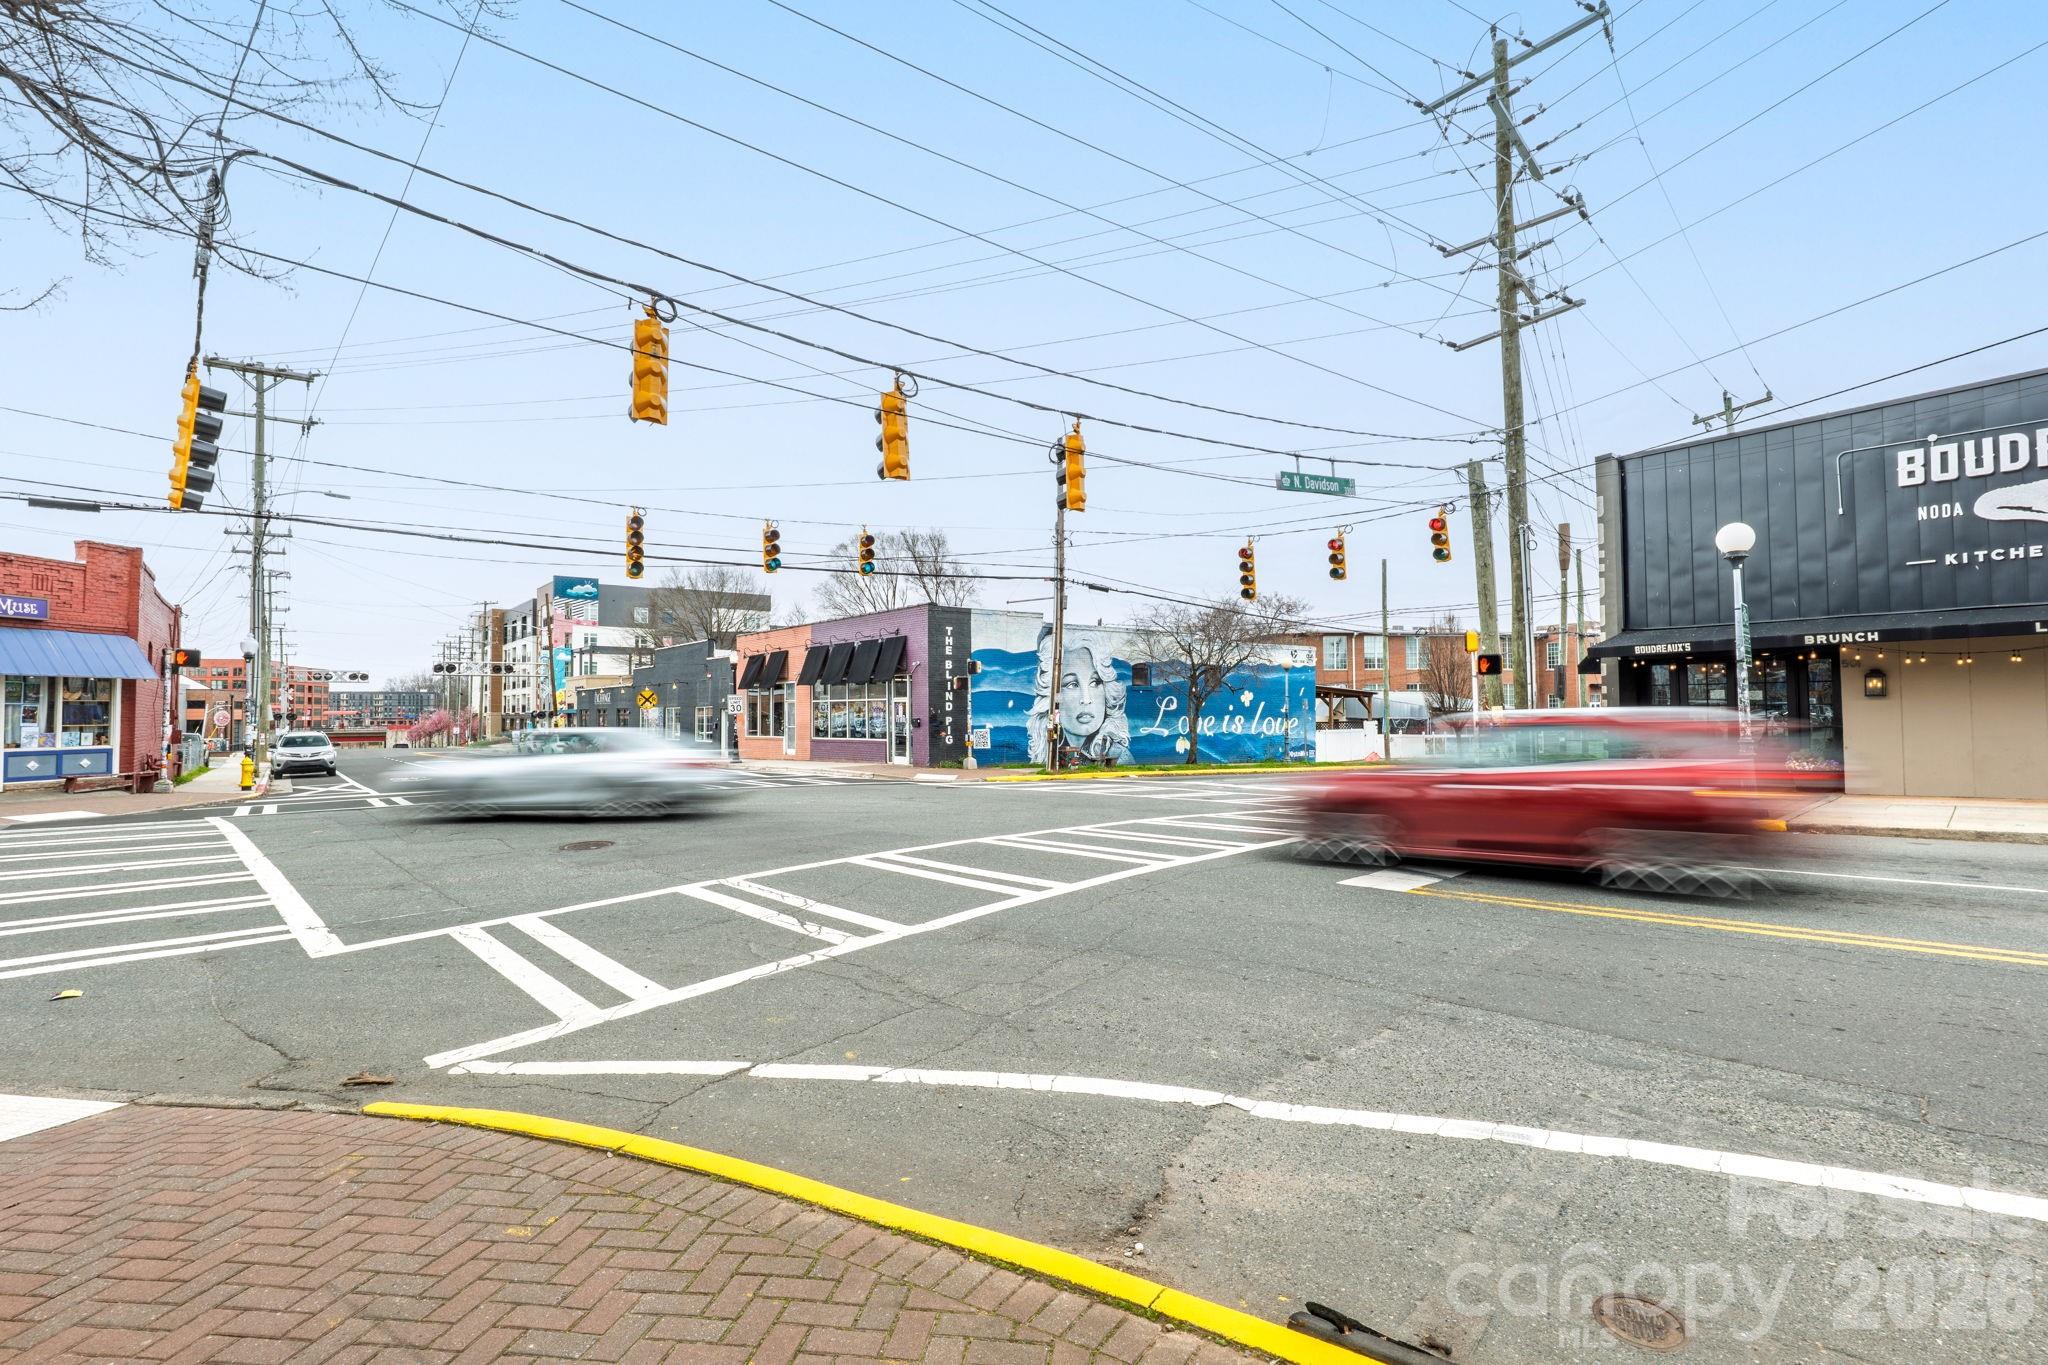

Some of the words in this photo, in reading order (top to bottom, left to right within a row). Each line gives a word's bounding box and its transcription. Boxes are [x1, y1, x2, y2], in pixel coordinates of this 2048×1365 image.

[1304, 476, 1339, 491] Davidson
[1918, 502, 1964, 521] NODA
[1945, 545, 2043, 565] KITCHE
[945, 626, 954, 655] THE
[1634, 643, 1691, 654] BOUDREAUX'S
[1804, 632, 1879, 645] BRUNCH
[945, 660, 953, 711] BLIND
[730, 704, 742, 713] 30
[1222, 704, 1245, 734] is
[945, 716, 954, 745] PIG
